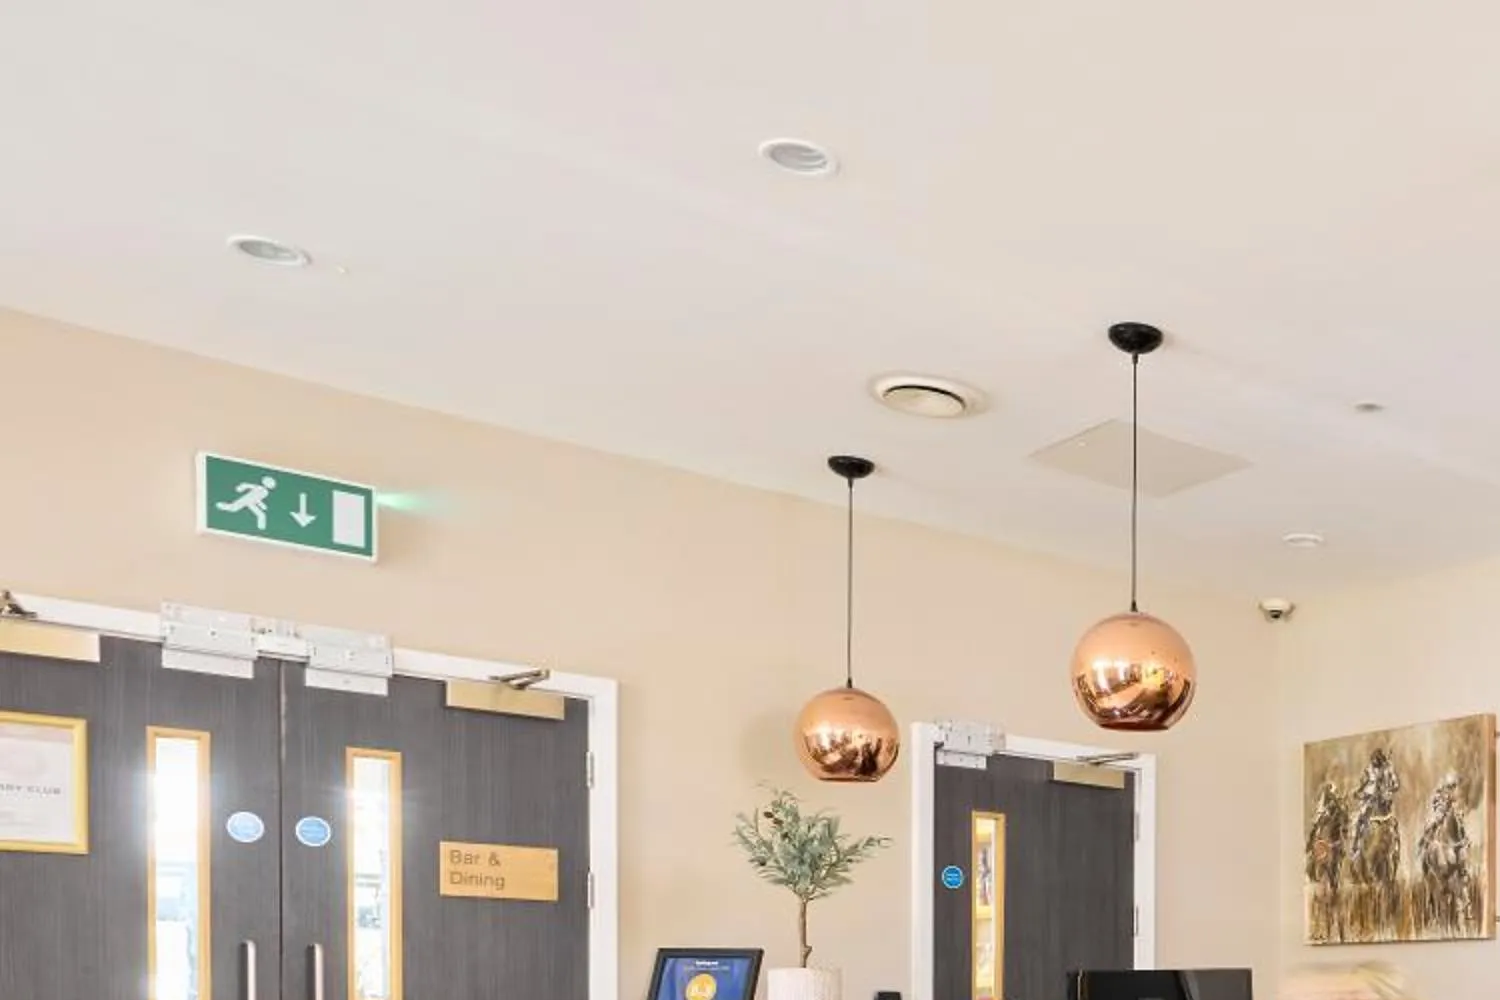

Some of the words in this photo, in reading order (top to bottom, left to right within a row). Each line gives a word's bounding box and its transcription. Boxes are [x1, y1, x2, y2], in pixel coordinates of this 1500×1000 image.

[449, 849, 481, 865] Bar
[487, 852, 502, 866] &
[449, 871, 506, 891] Dining
